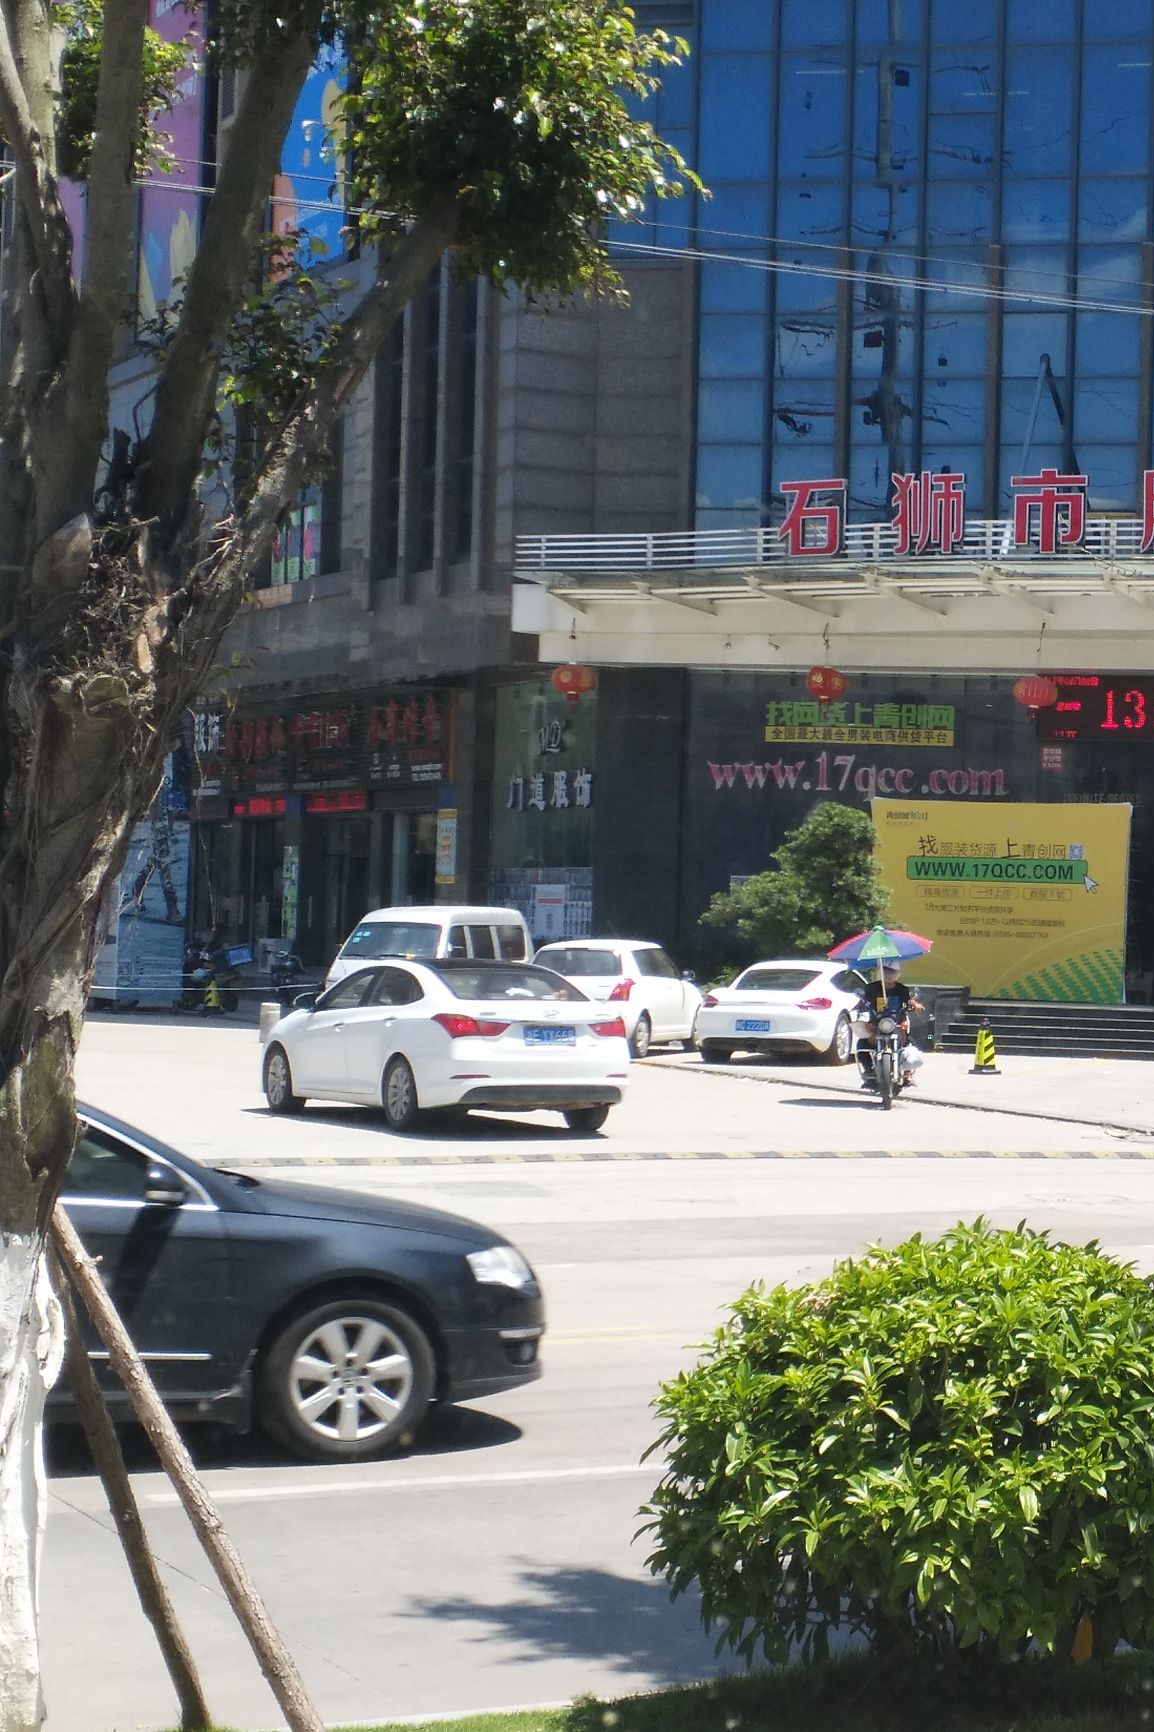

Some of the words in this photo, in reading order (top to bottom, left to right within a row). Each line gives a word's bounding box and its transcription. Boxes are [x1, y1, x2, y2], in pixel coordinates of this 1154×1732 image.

[507, 768, 593, 812] 门道服饰
[707, 751, 1010, 801] www.17qcc.com
[915, 861, 1074, 880] WWW.17QCC.COM
